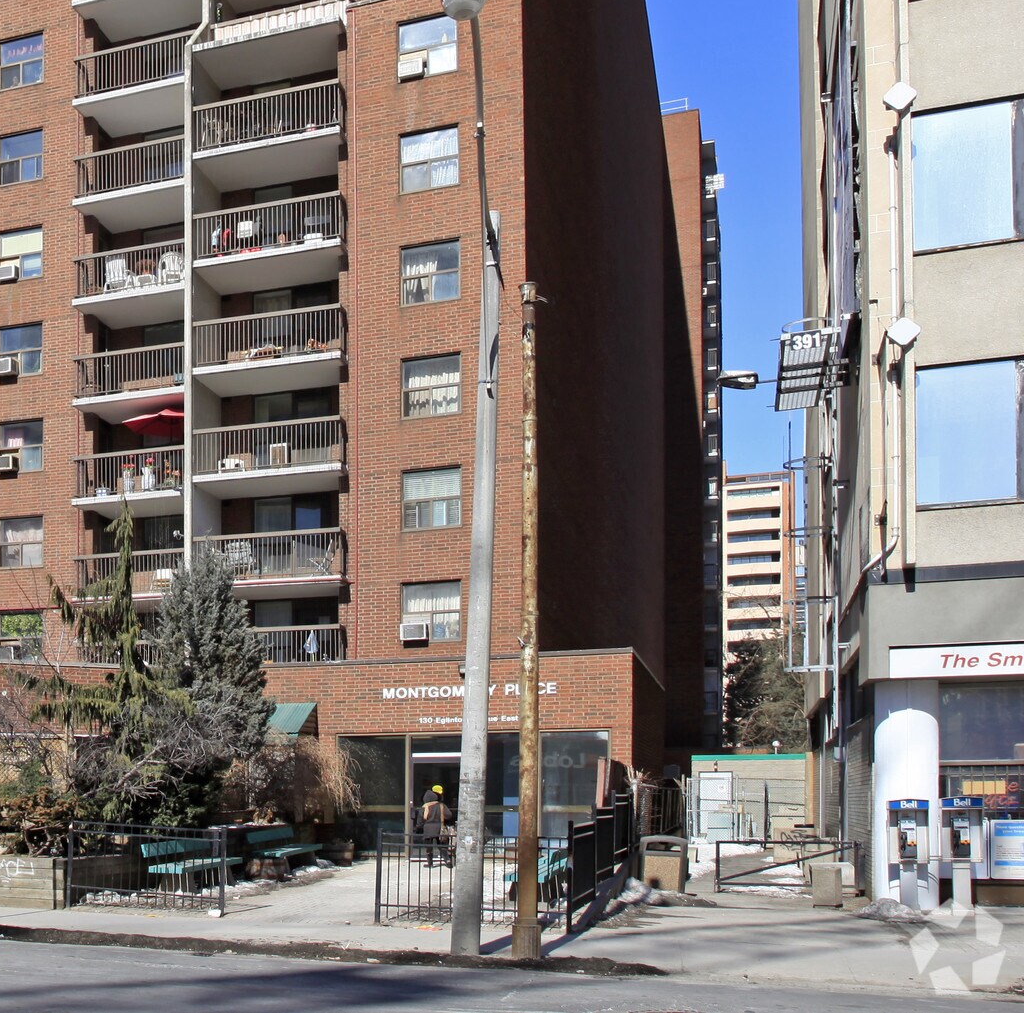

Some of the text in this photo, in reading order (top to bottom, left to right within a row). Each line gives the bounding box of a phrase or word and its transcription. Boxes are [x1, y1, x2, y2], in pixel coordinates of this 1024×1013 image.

[792, 333, 821, 350] 391
[940, 652, 1024, 669] The Sm
[382, 682, 557, 699] MONTGOMY PLCE
[436, 716, 463, 725] Eglinto
[900, 800, 917, 809] Bell
[953, 798, 971, 807] Bell
